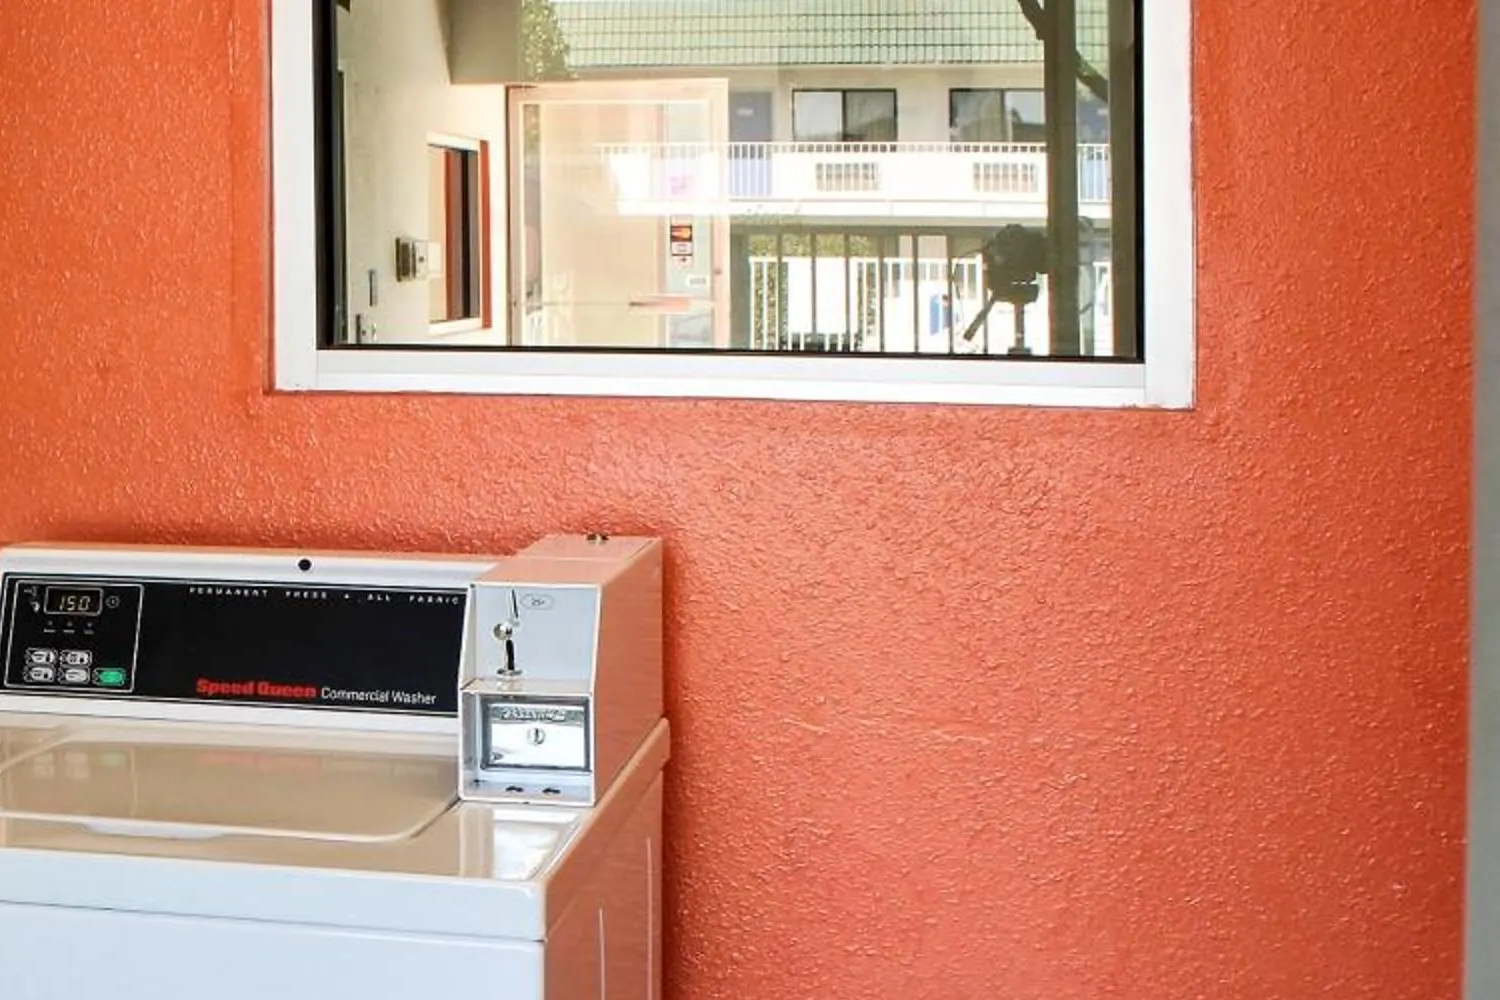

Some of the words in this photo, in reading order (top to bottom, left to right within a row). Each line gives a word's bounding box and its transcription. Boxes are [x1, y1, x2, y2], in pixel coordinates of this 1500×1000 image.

[188, 586, 269, 598] PERMANENT
[58, 595, 92, 612] 150
[195, 677, 254, 697] Speed
[257, 679, 318, 698] Queen
[320, 686, 389, 703] Commercial
[392, 690, 437, 705] Washer
